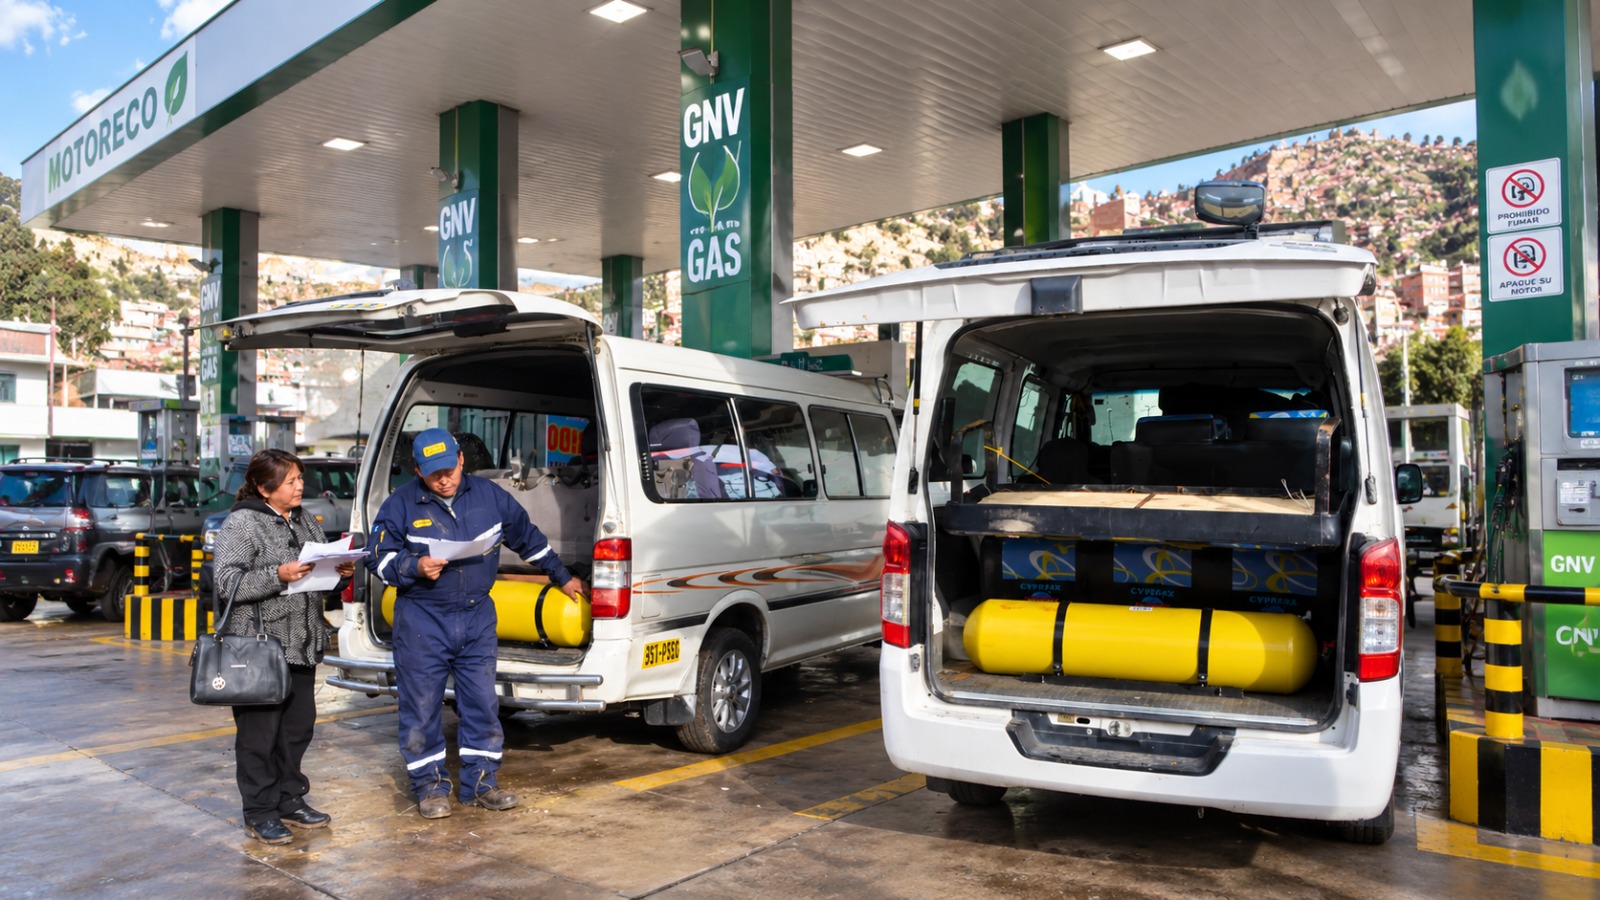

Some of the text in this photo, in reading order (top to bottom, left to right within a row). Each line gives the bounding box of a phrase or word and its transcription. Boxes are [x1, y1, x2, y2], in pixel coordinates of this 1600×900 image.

[683, 87, 745, 148] GNV
[48, 86, 158, 194] MOTORECO
[440, 197, 476, 241] GNV
[687, 232, 742, 283] GAS
[200, 280, 221, 313] GNV
[201, 356, 218, 381] GAS
[1550, 555, 1595, 574] GNV
